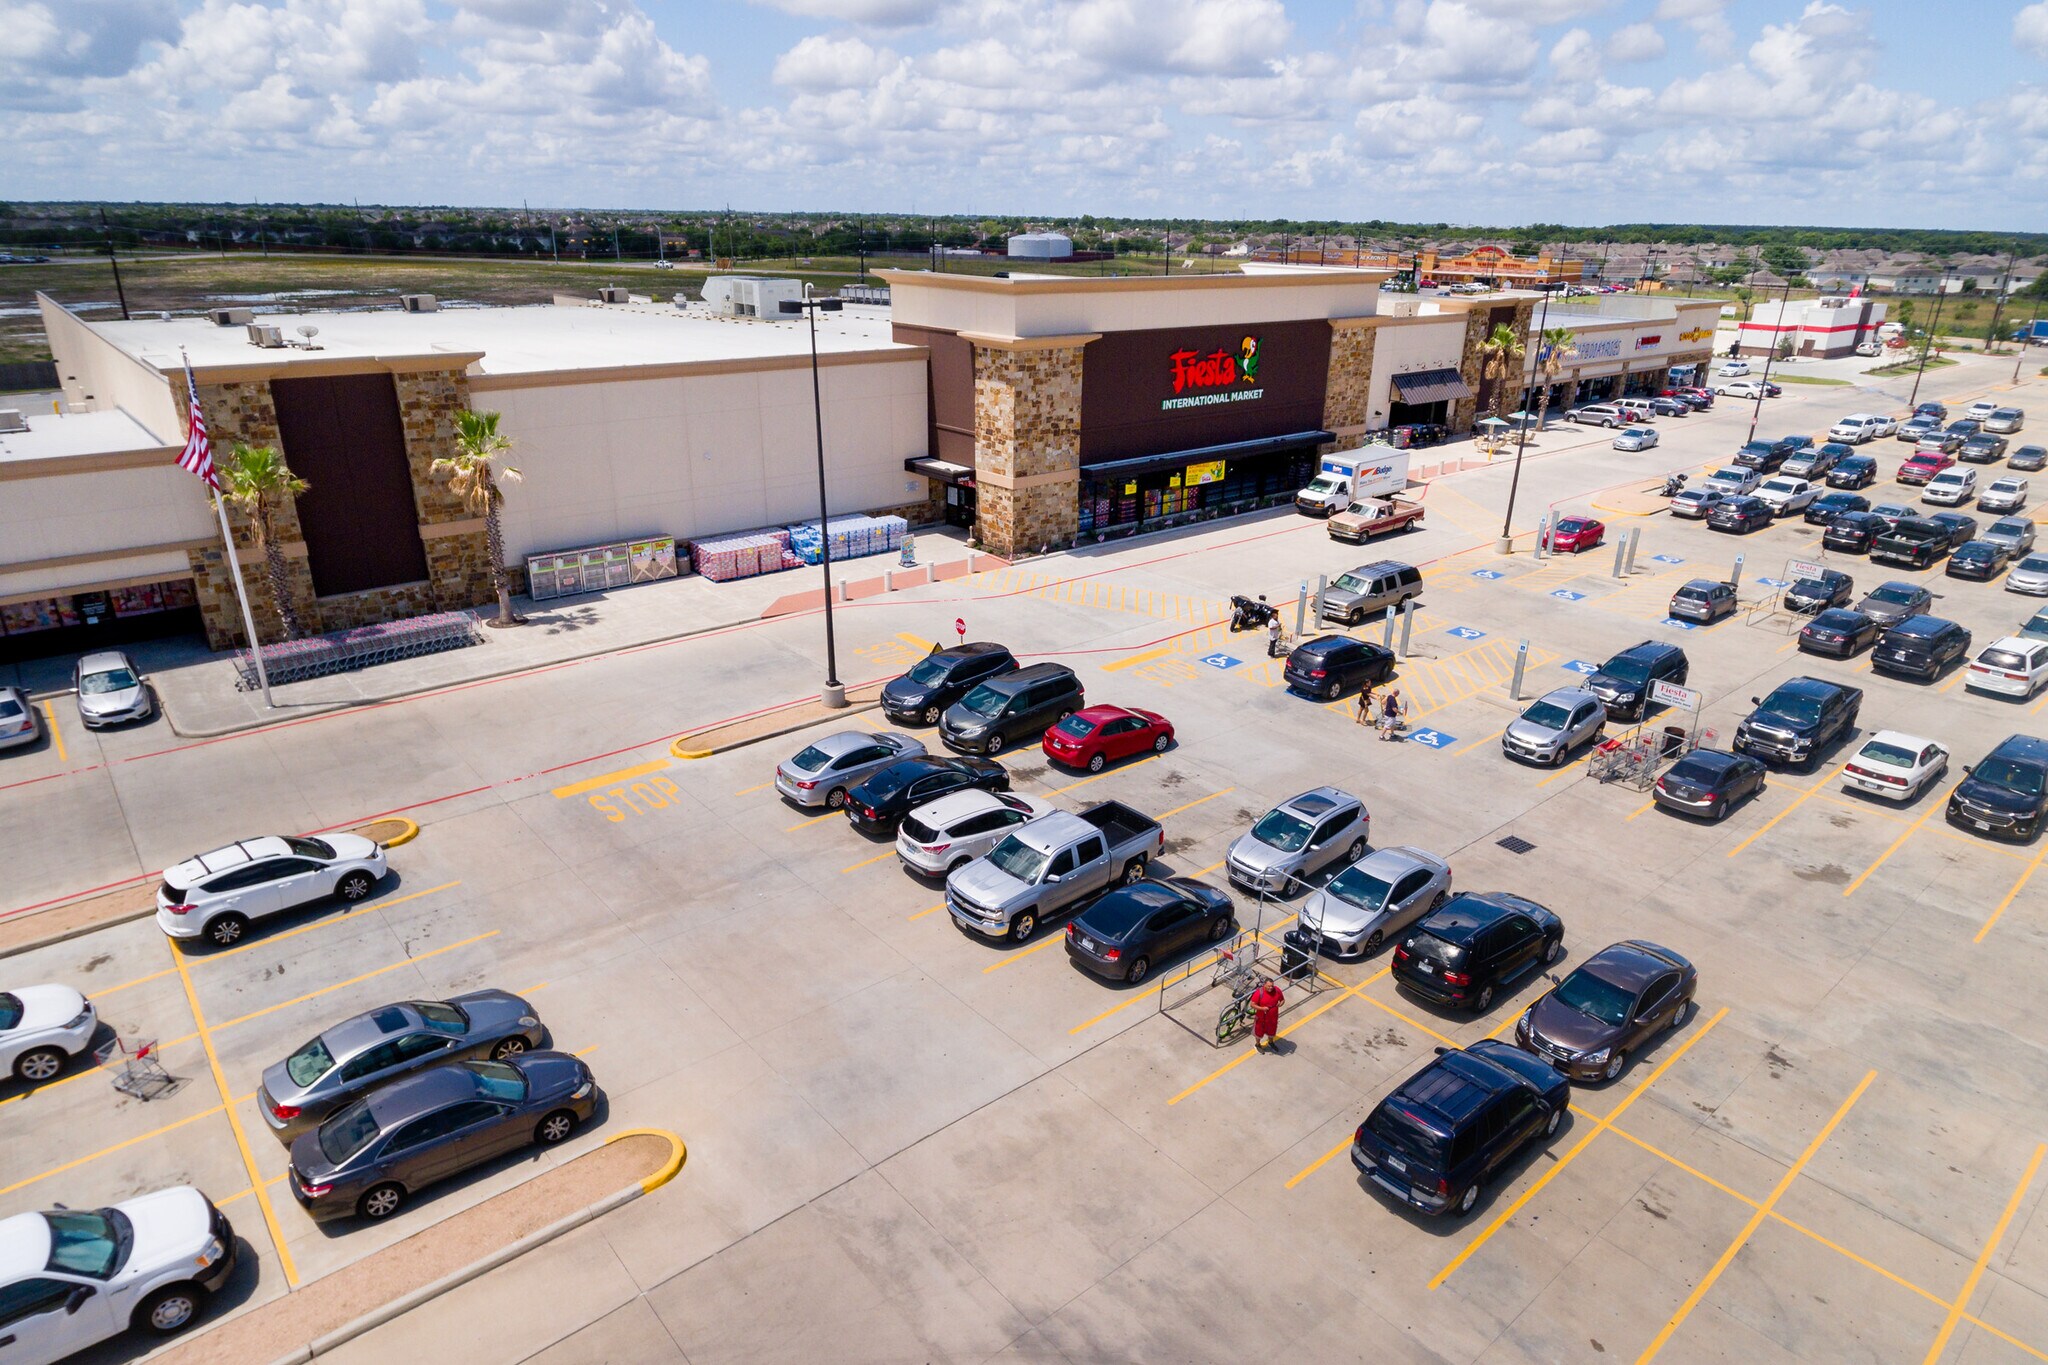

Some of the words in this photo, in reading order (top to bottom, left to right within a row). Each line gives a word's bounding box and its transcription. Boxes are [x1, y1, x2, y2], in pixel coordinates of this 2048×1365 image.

[1169, 347, 1236, 394] Fiesta
[1162, 394, 1229, 410] INTERNATIONAL
[1231, 389, 1263, 401] MARKET
[1660, 684, 1687, 699] Fiesta
[588, 777, 681, 823] STOP
